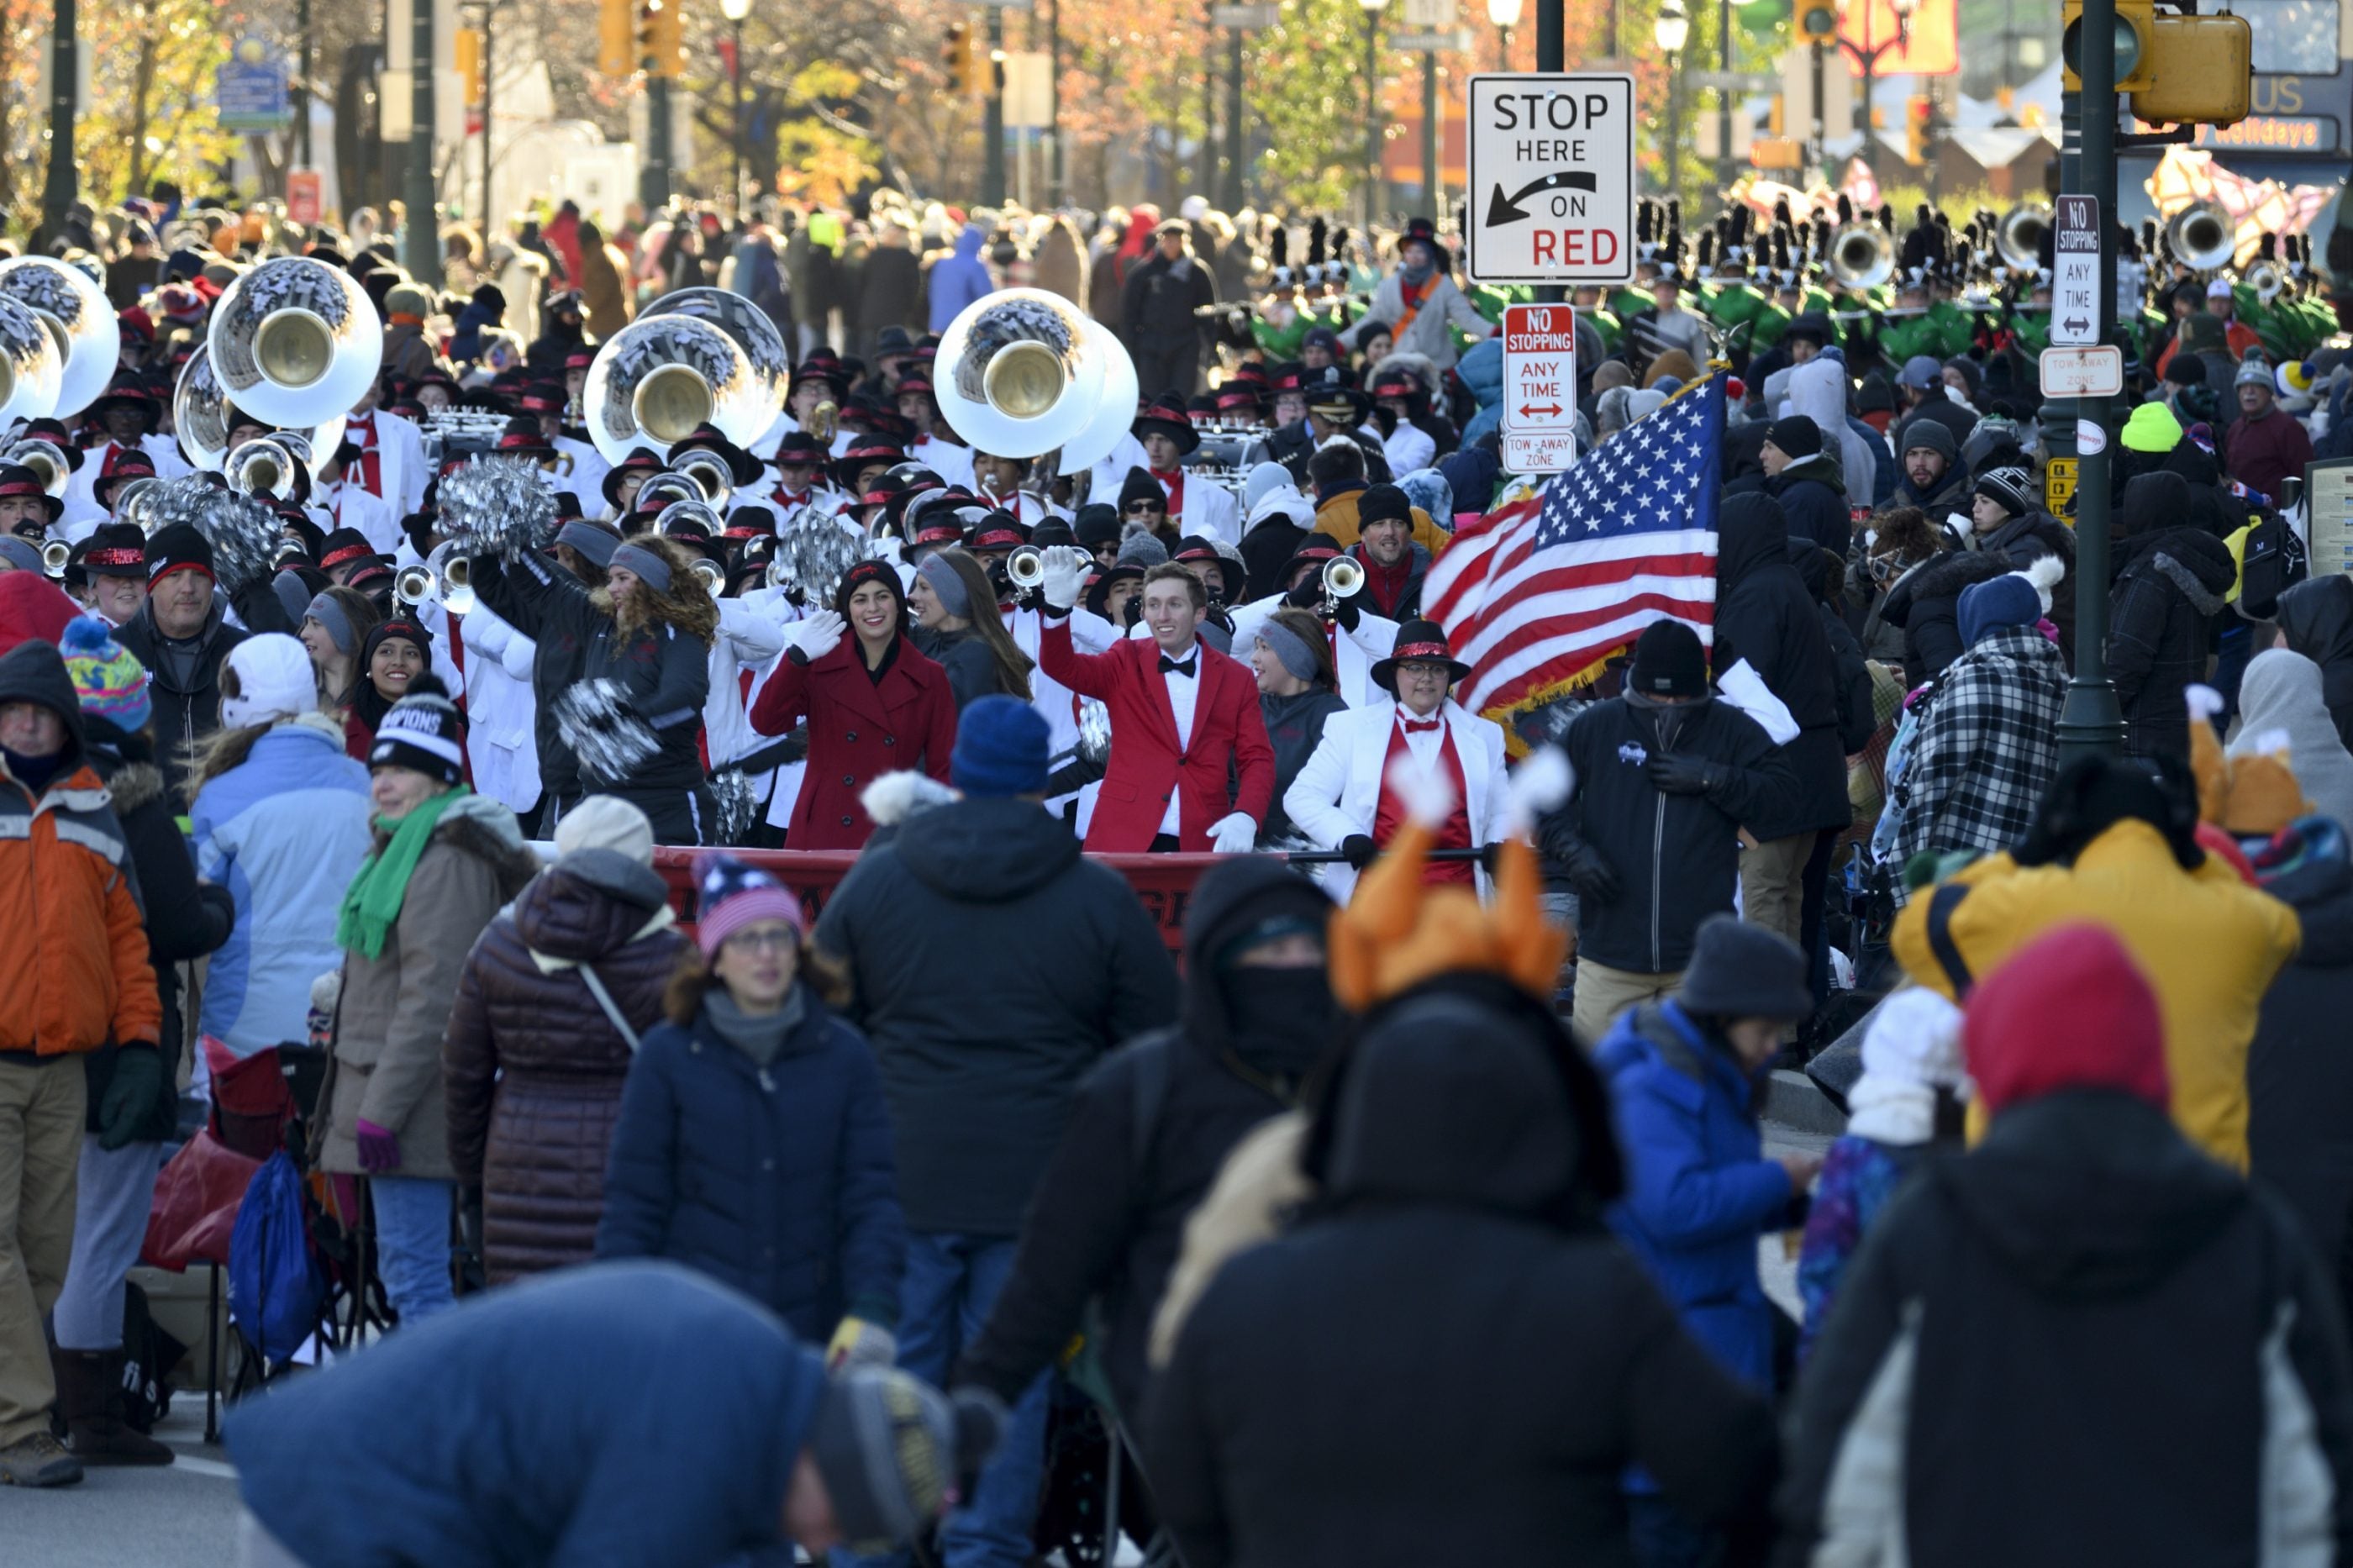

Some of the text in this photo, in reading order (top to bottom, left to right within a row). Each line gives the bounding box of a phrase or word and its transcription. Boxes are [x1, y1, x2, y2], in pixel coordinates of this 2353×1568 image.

[1494, 94, 1608, 130] STOP
[1517, 139, 1586, 161] HERE
[1551, 196, 1586, 217] ON
[2069, 202, 2087, 229] NO
[1533, 229, 1619, 266] RED
[2060, 230, 2098, 250] STOPPING
[2066, 263, 2090, 282] ANY
[2066, 291, 2090, 308] TIME
[1527, 308, 1552, 333] NO
[1509, 332, 1571, 350] STOPPING
[1521, 361, 1560, 377] ANY
[1520, 382, 1561, 397] TIME
[2067, 375, 2095, 386] ZONE
[1526, 454, 1554, 466] ZONE
